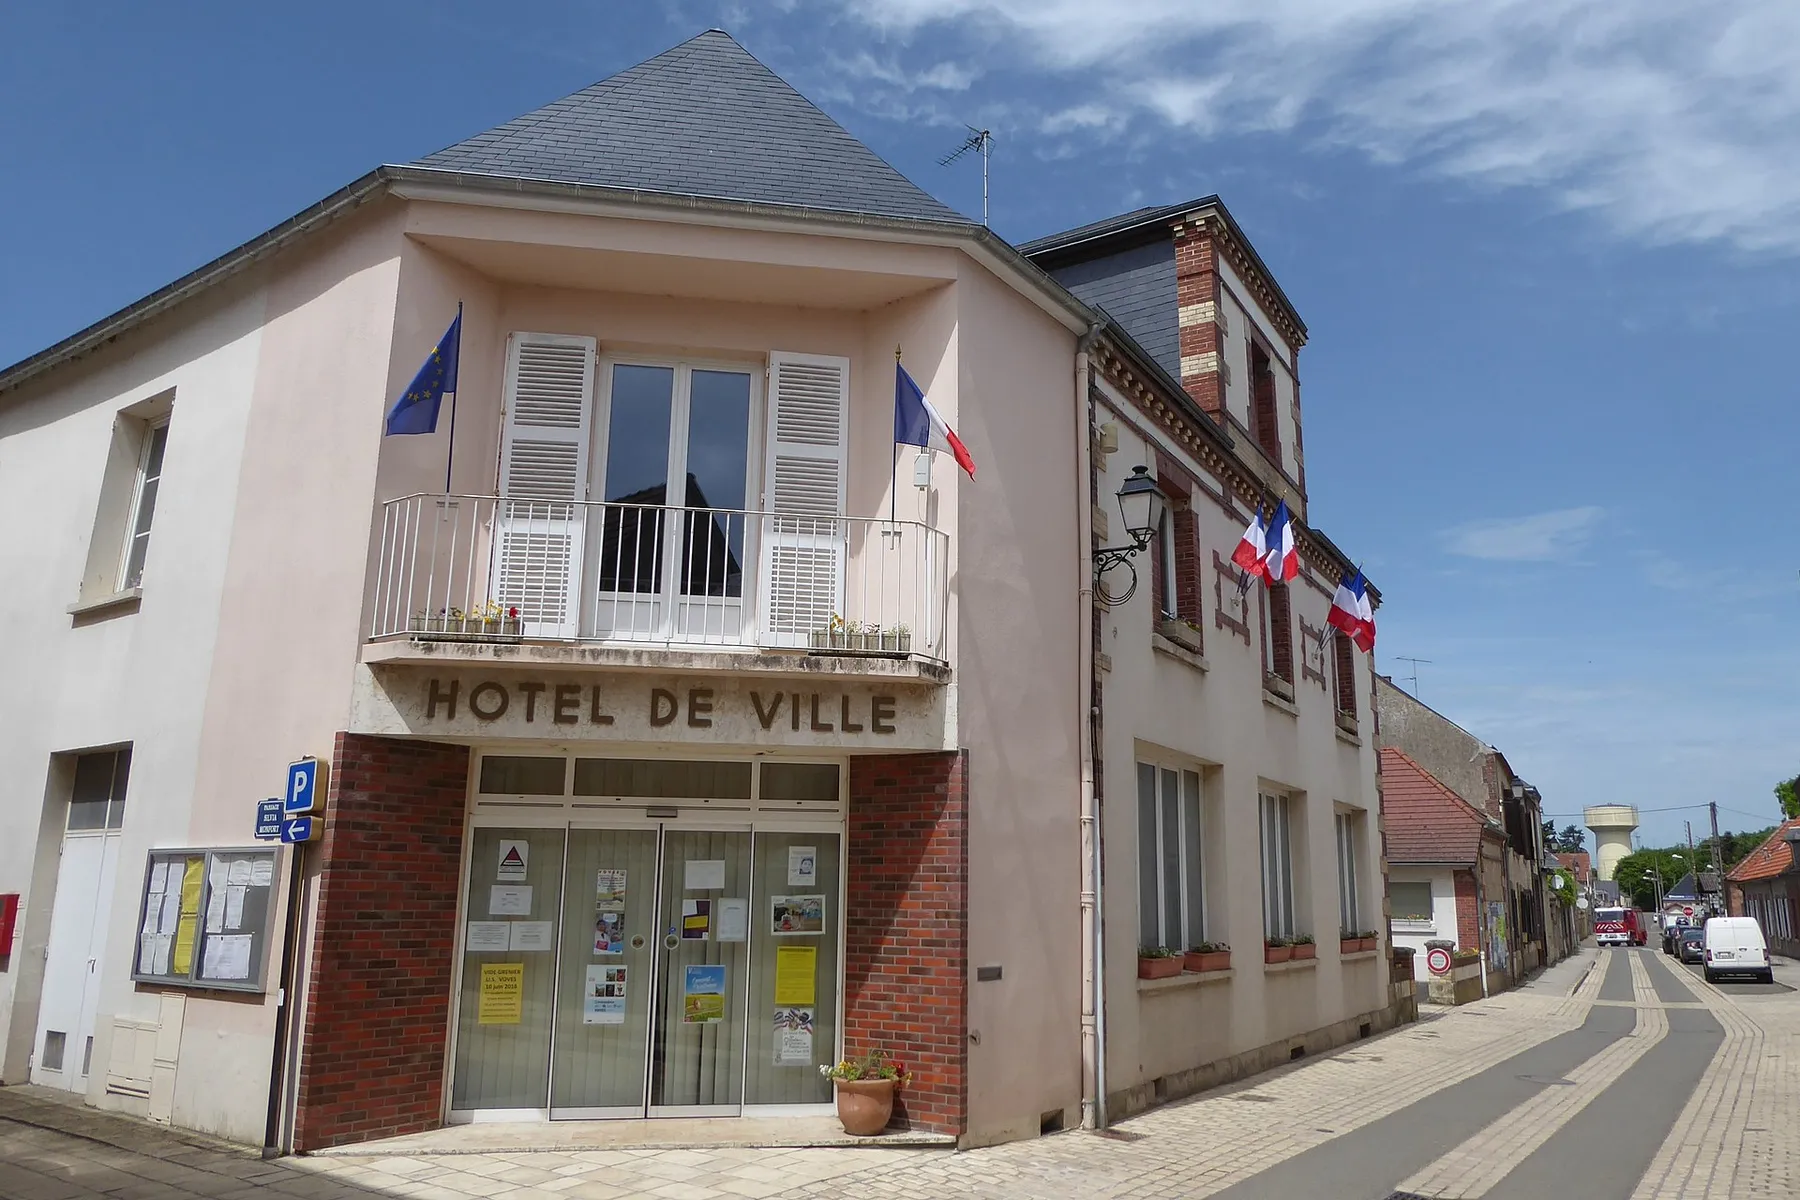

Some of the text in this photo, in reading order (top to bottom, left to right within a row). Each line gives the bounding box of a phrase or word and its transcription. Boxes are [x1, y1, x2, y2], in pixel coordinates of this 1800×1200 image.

[426, 678, 897, 734] HOTEL DE VILLE
[293, 771, 308, 802] P
